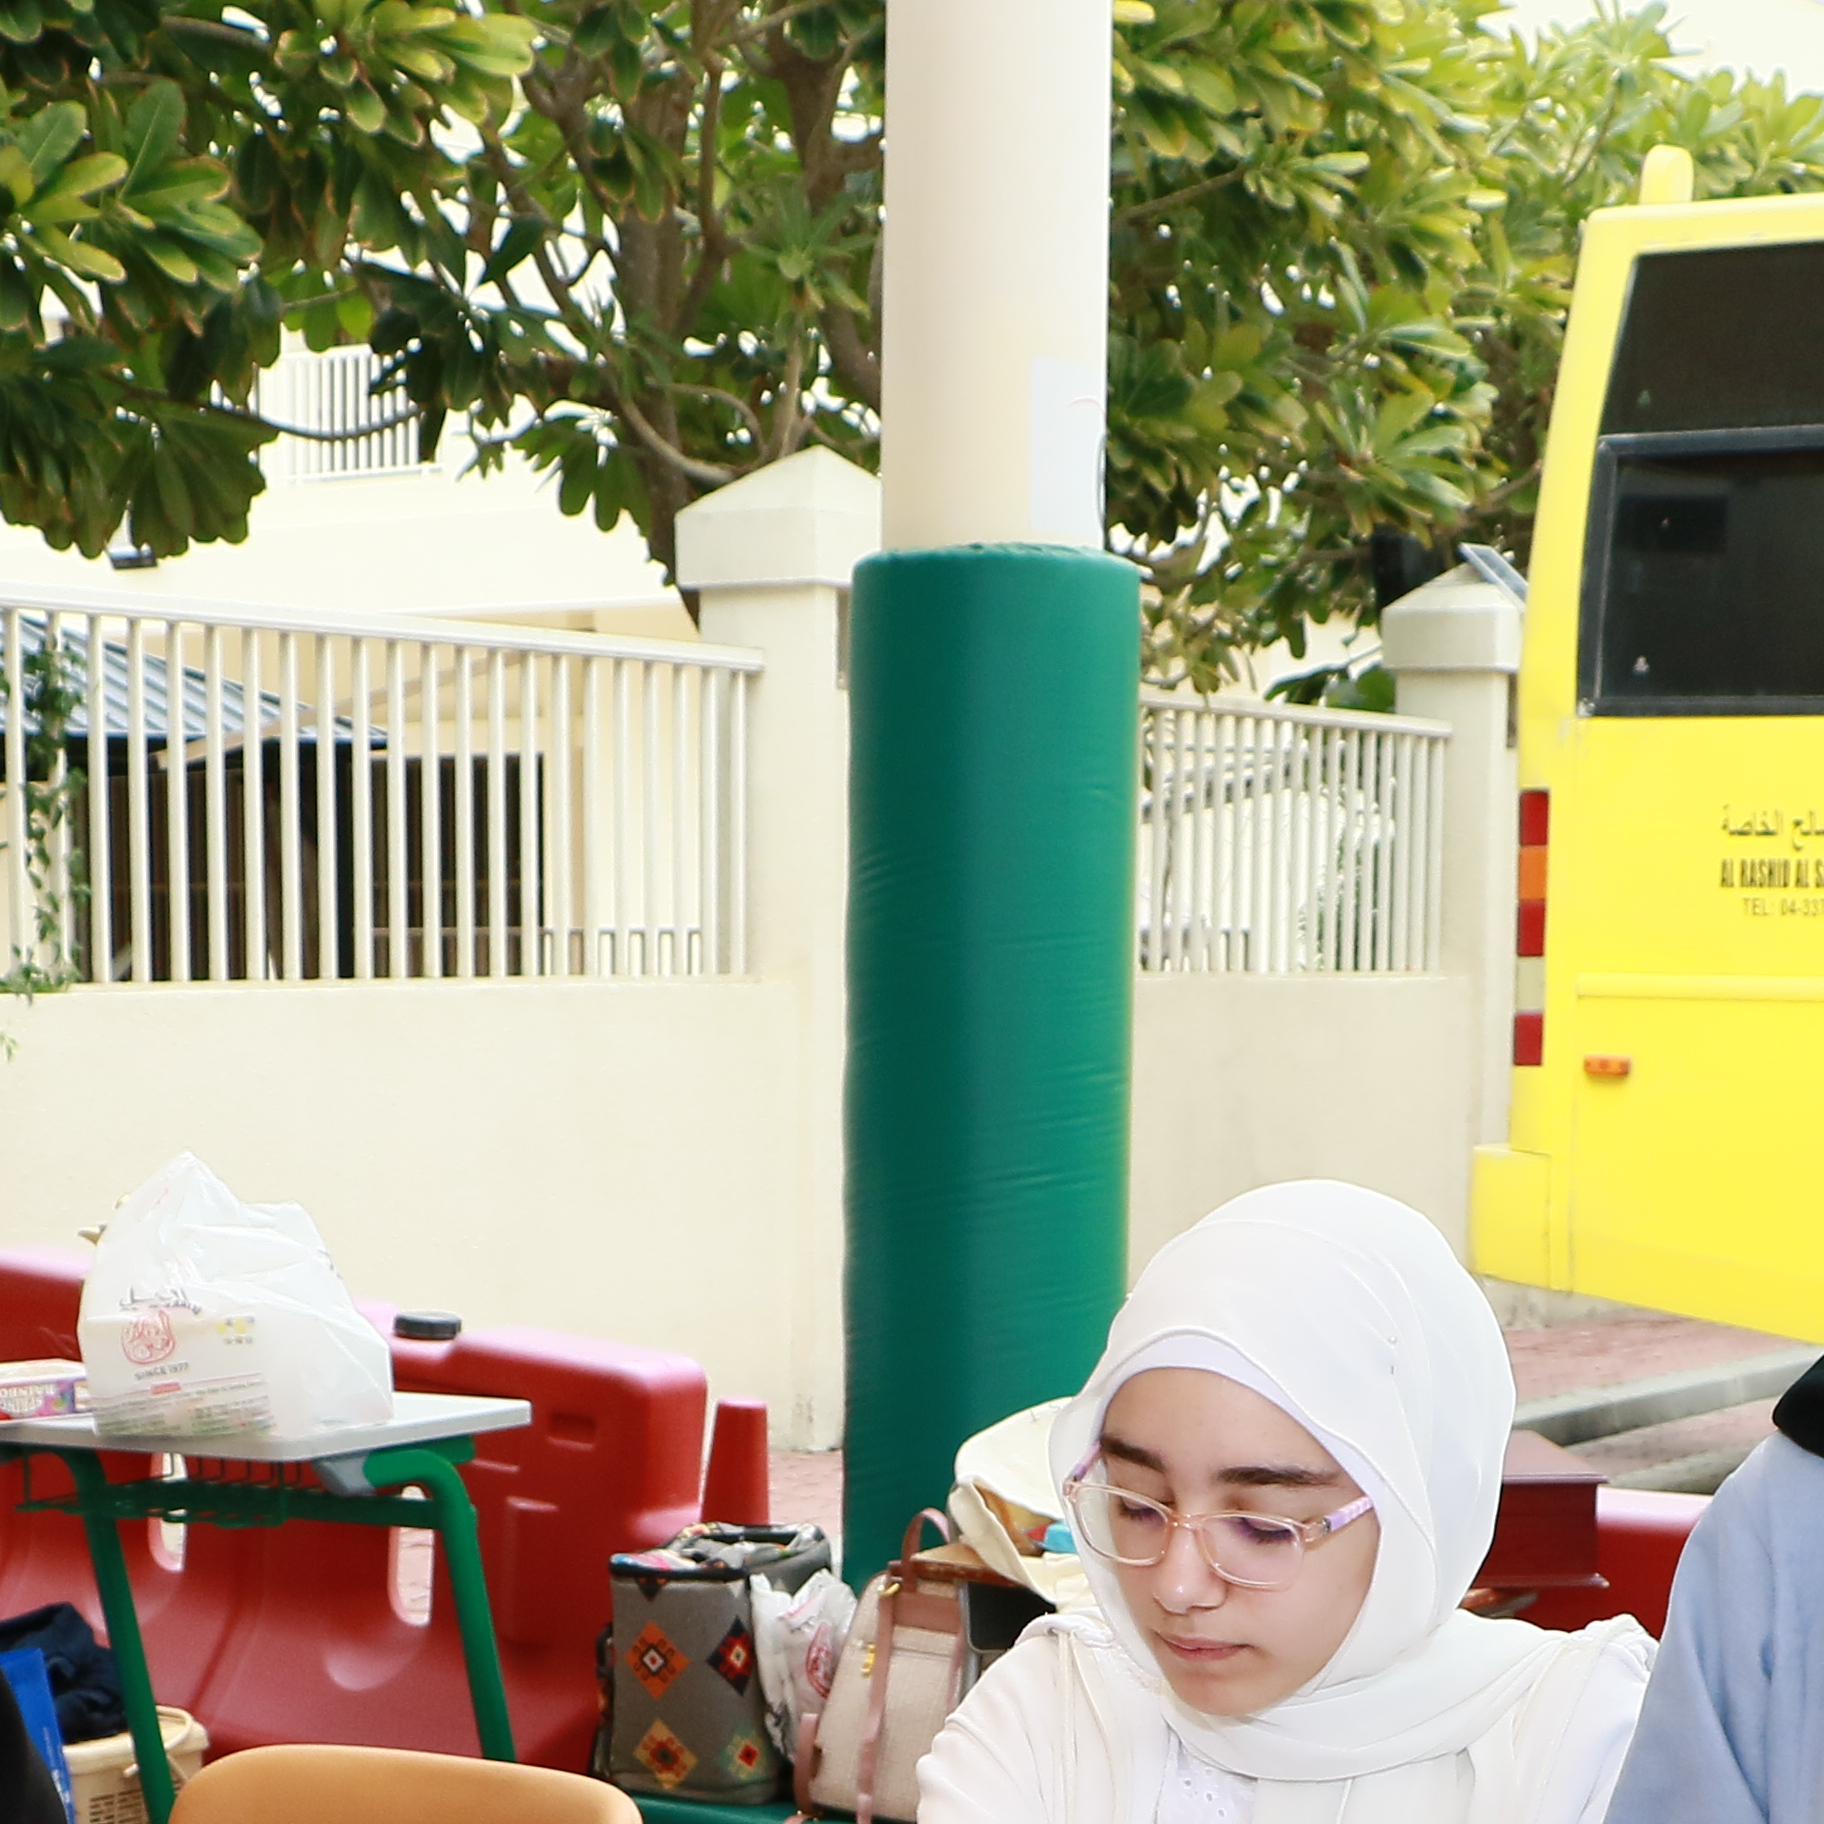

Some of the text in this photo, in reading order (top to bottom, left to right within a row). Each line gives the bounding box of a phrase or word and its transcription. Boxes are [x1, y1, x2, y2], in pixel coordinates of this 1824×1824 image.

[1721, 858, 1734, 888] AL
[1740, 858, 1790, 888] RASHID
[1795, 858, 1809, 888] AL
